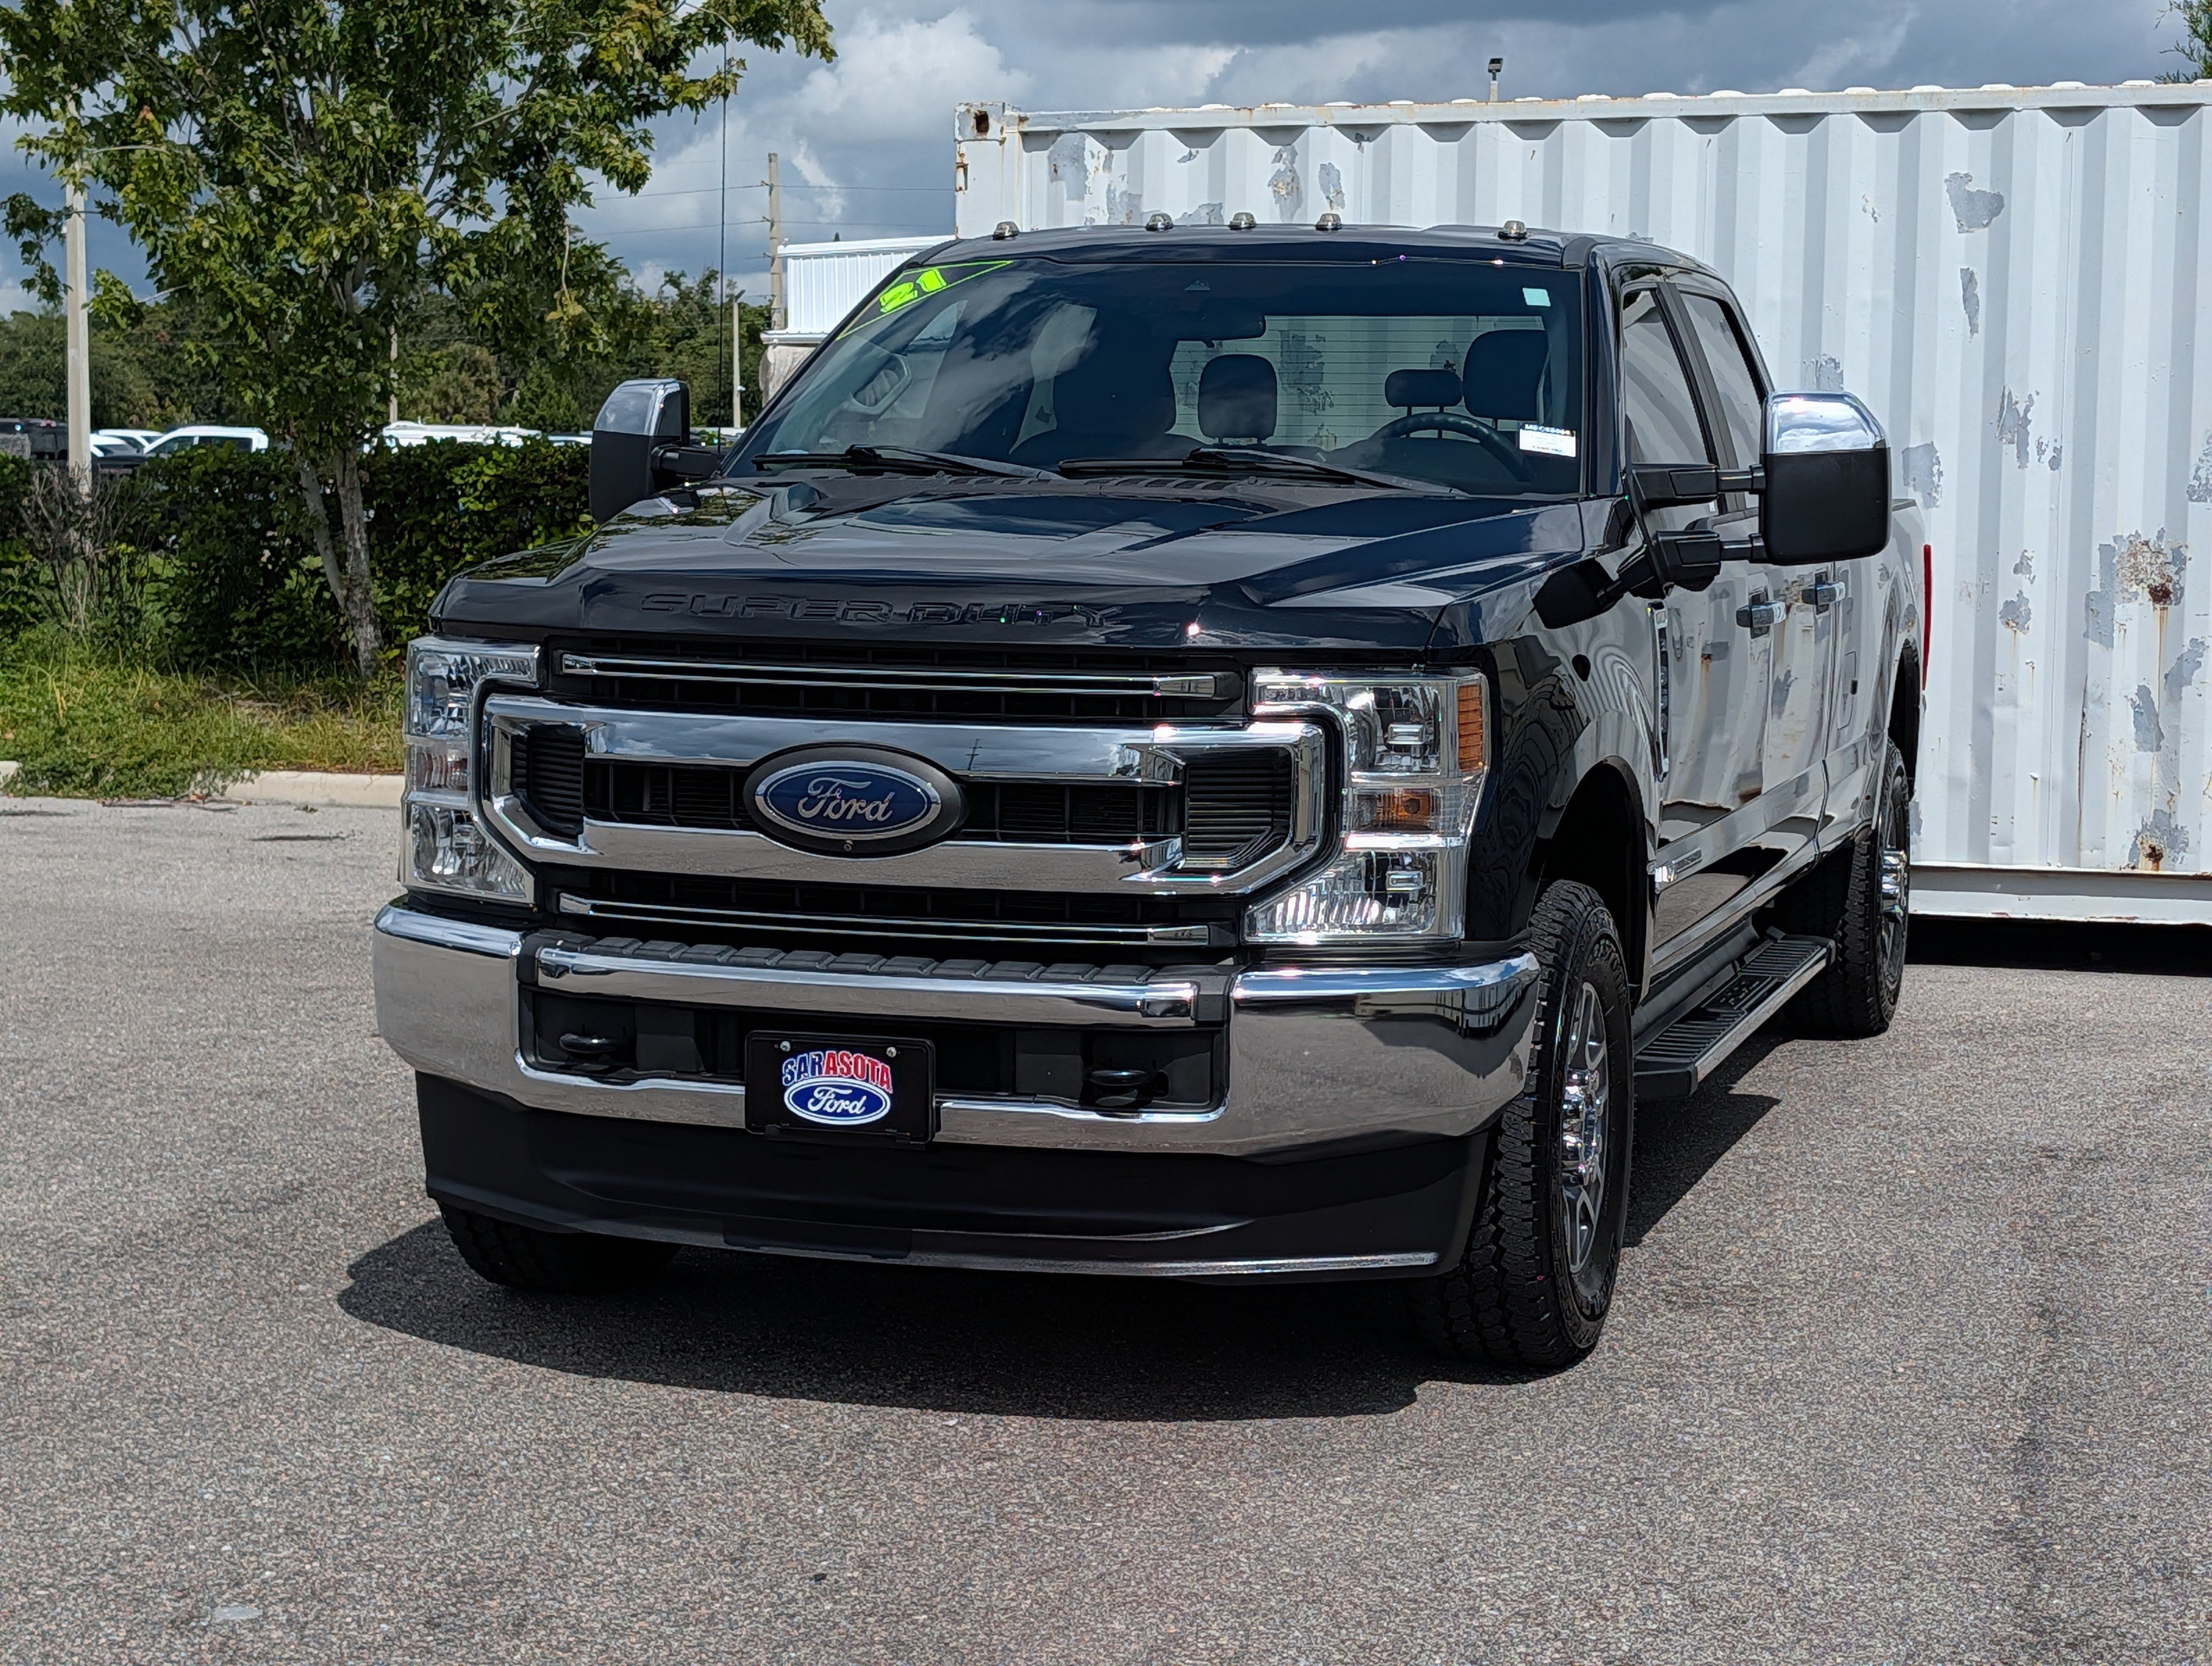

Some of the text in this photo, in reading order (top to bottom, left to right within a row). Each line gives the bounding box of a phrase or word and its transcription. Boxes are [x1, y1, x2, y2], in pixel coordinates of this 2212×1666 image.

[640, 593, 893, 622] SUPER
[797, 777, 896, 822] Ford
[781, 1049, 893, 1094] SARASOTA
[807, 1086, 866, 1114] Ford
